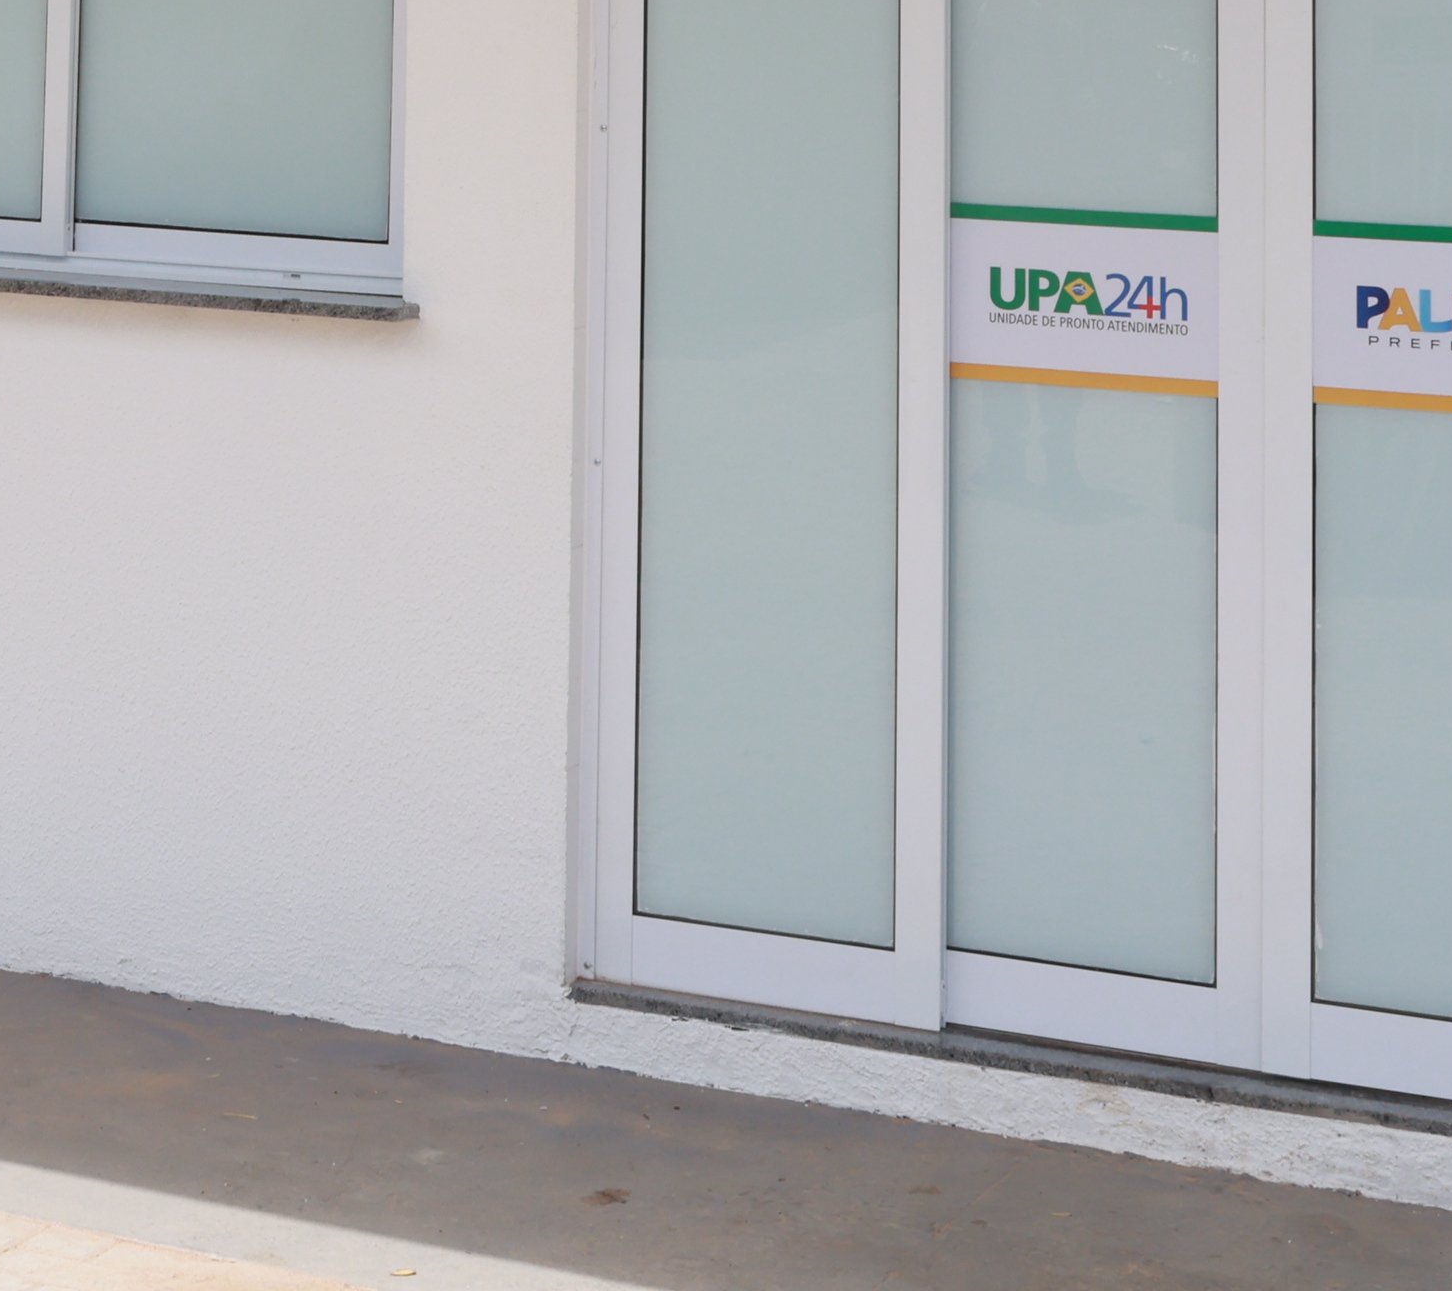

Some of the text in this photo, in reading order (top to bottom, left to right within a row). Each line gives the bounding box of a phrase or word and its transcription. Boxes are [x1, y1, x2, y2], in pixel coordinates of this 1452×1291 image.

[989, 312, 1188, 336] UNIDADE DE PRONTO ATENDIMENTO
